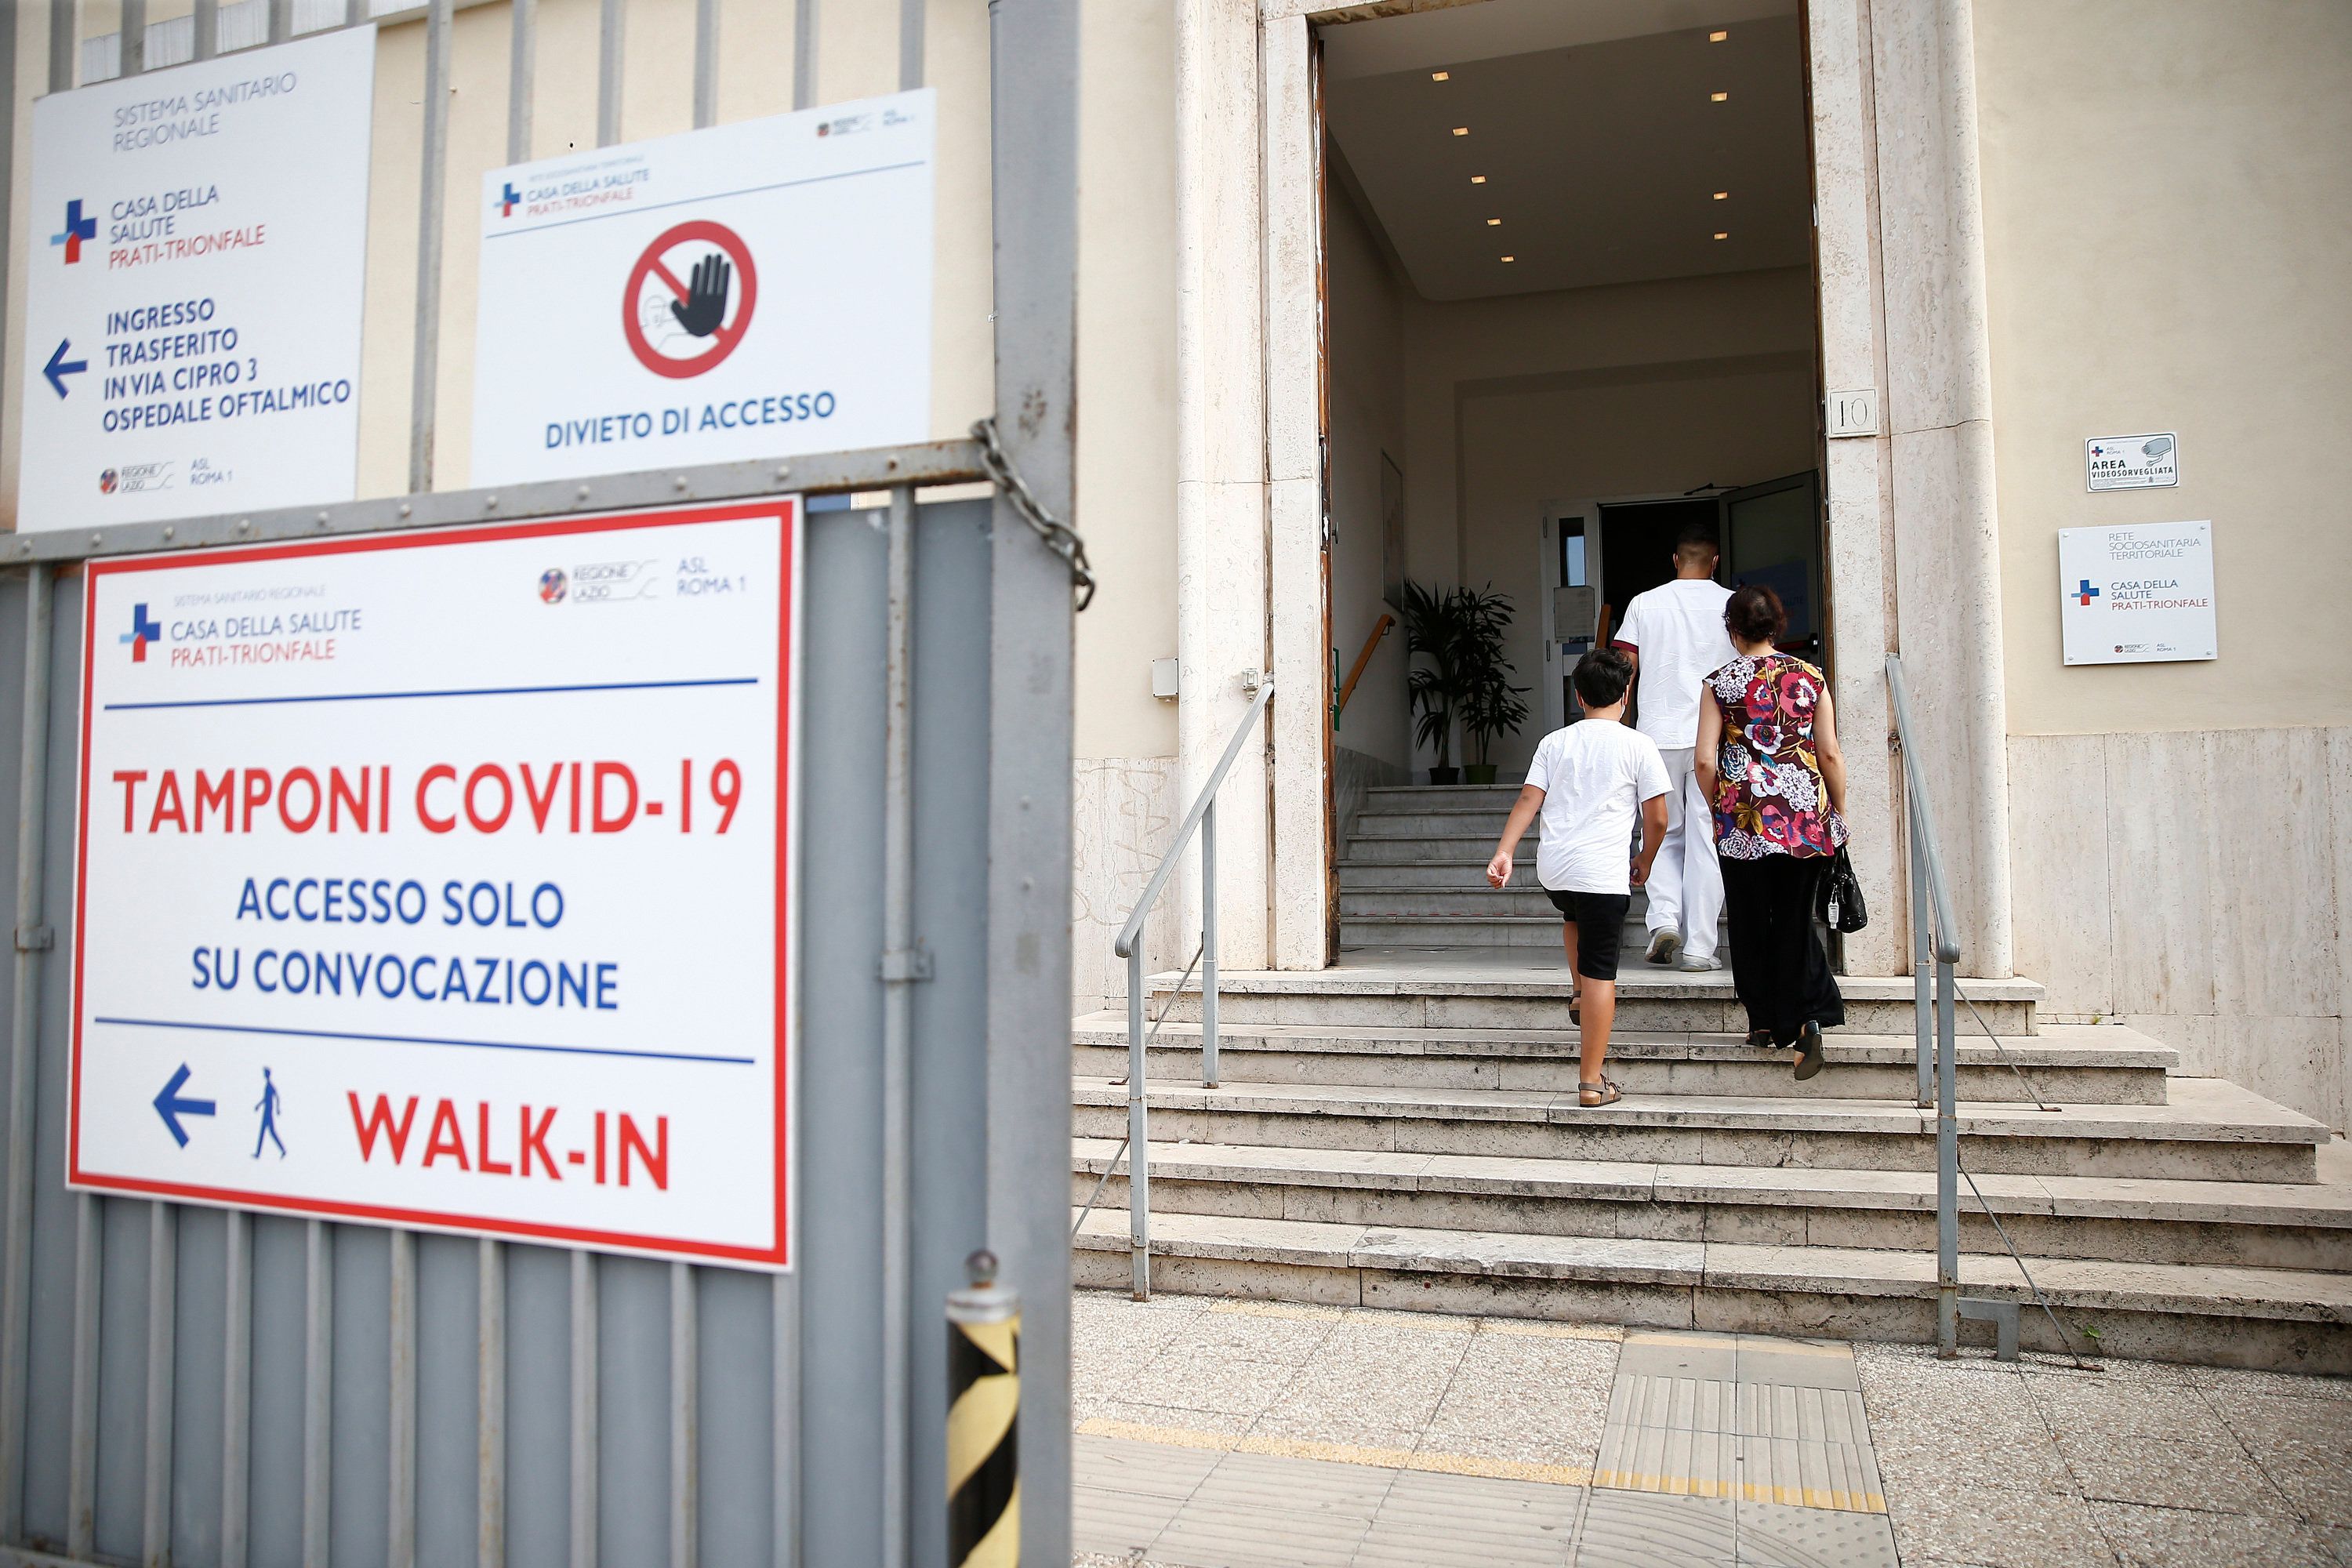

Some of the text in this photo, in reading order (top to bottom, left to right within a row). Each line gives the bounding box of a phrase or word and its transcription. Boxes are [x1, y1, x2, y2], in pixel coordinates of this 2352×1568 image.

[114, 71, 296, 128] SISTEMA SANITARIO
[114, 114, 220, 152] REGIONALE
[527, 169, 649, 202] CASA DELLA SALUTE
[111, 185, 219, 220] CASA DELLA
[527, 187, 633, 216] PRATI-TRIONFALE
[111, 216, 175, 245] SALUTE
[109, 225, 265, 270] PRATI-TRIONFALE
[107, 298, 215, 336] INGRESSO
[106, 328, 238, 368] TRASFERITO
[173, 361, 239, 390] CIPRO
[247, 358, 257, 381] 3
[103, 379, 350, 432] OSPEDALE OFTALMICO
[546, 390, 835, 448] DIVIETO DI ACCESSO
[1840, 398, 1867, 427] 10
[191, 458, 210, 470] ASL
[191, 470, 232, 485] ROMA 1
[2092, 459, 2125, 470] AREA
[2092, 466, 2173, 478] VIDEOSORVEGLIATA
[2109, 532, 2134, 541] RETE
[2109, 538, 2201, 551] SOCIOSANITARIA
[678, 557, 708, 574] ASL
[2109, 549, 2183, 561] TERRITORIALE
[677, 575, 746, 595] ROMA 1
[2111, 579, 2178, 590] CASA DELLA
[2111, 590, 2152, 600] SALUTE
[2111, 598, 2208, 611] PRATI-TRIONFALE
[171, 609, 362, 641] CASA DELLA SALUTE
[172, 639, 336, 666] PRATI-TRIONFALE
[112, 757, 743, 836] TAMPONI COVID-19
[236, 877, 565, 929] ACCESSO SOLO
[192, 946, 619, 1011] SU CONVOCAZIONE
[347, 1089, 670, 1192] WALK-IN
